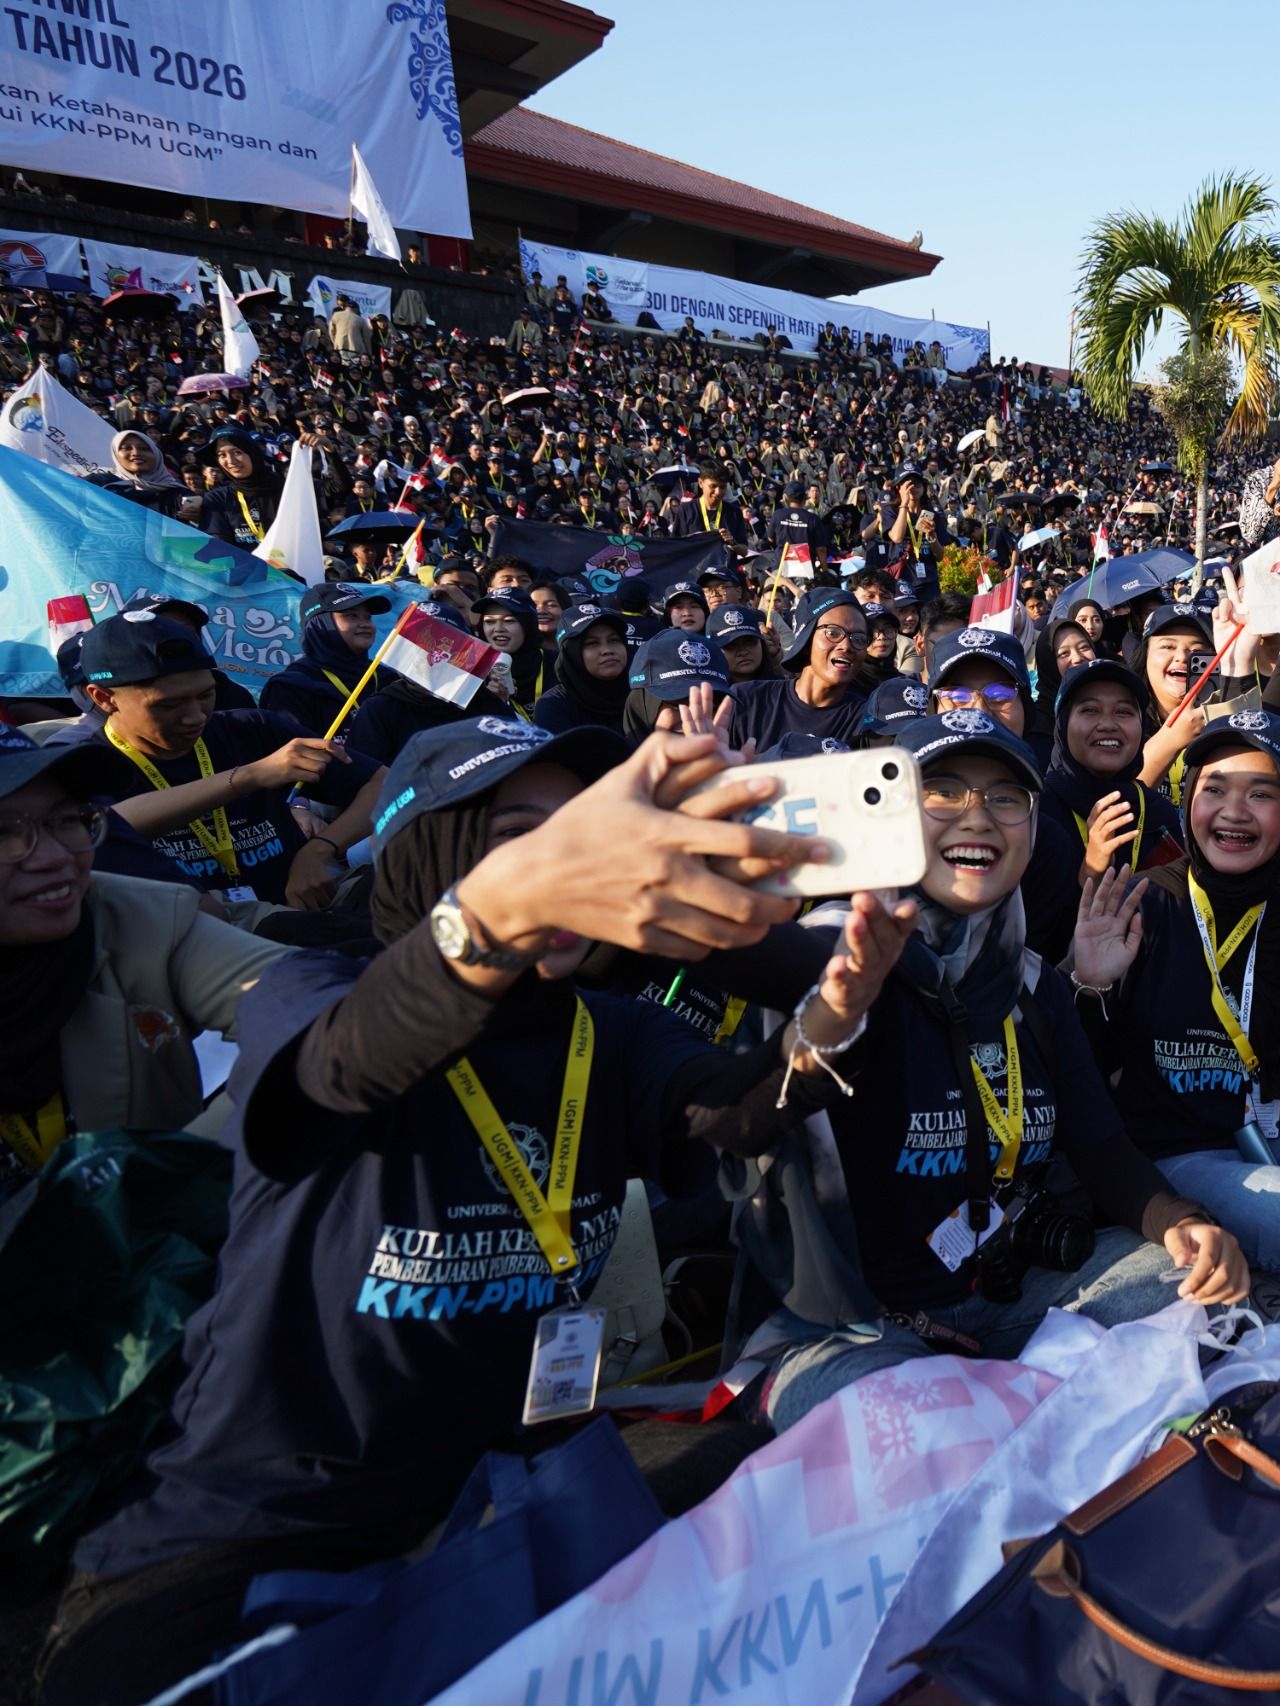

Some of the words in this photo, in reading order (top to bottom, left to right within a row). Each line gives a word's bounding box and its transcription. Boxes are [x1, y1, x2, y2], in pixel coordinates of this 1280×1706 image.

[4, 7, 141, 78] TAHUN
[150, 45, 247, 101] 2026
[31, 110, 151, 149] KKN-PPM
[47, 91, 180, 134] Ketahanan
[188, 122, 272, 153] Pangan
[279, 140, 318, 160] dan
[671, 295, 725, 321] DENGAN
[728, 305, 786, 332] SEPENUH
[788, 316, 815, 337] HATI
[448, 742, 532, 780] UNIVERSITAS
[238, 820, 273, 840] NYATA
[241, 838, 284, 867] UGM
[1153, 1039, 1207, 1057] KULIAH
[1207, 1042, 1238, 1060] KER
[1186, 1028, 1226, 1041] UNIVERSITAS
[1153, 1054, 1201, 1070] PEMBELAJARAN
[375, 1224, 494, 1260] KULIAH
[369, 1251, 489, 1284] PEMBELAJARAN
[356, 1275, 555, 1321] KKN-PPM
